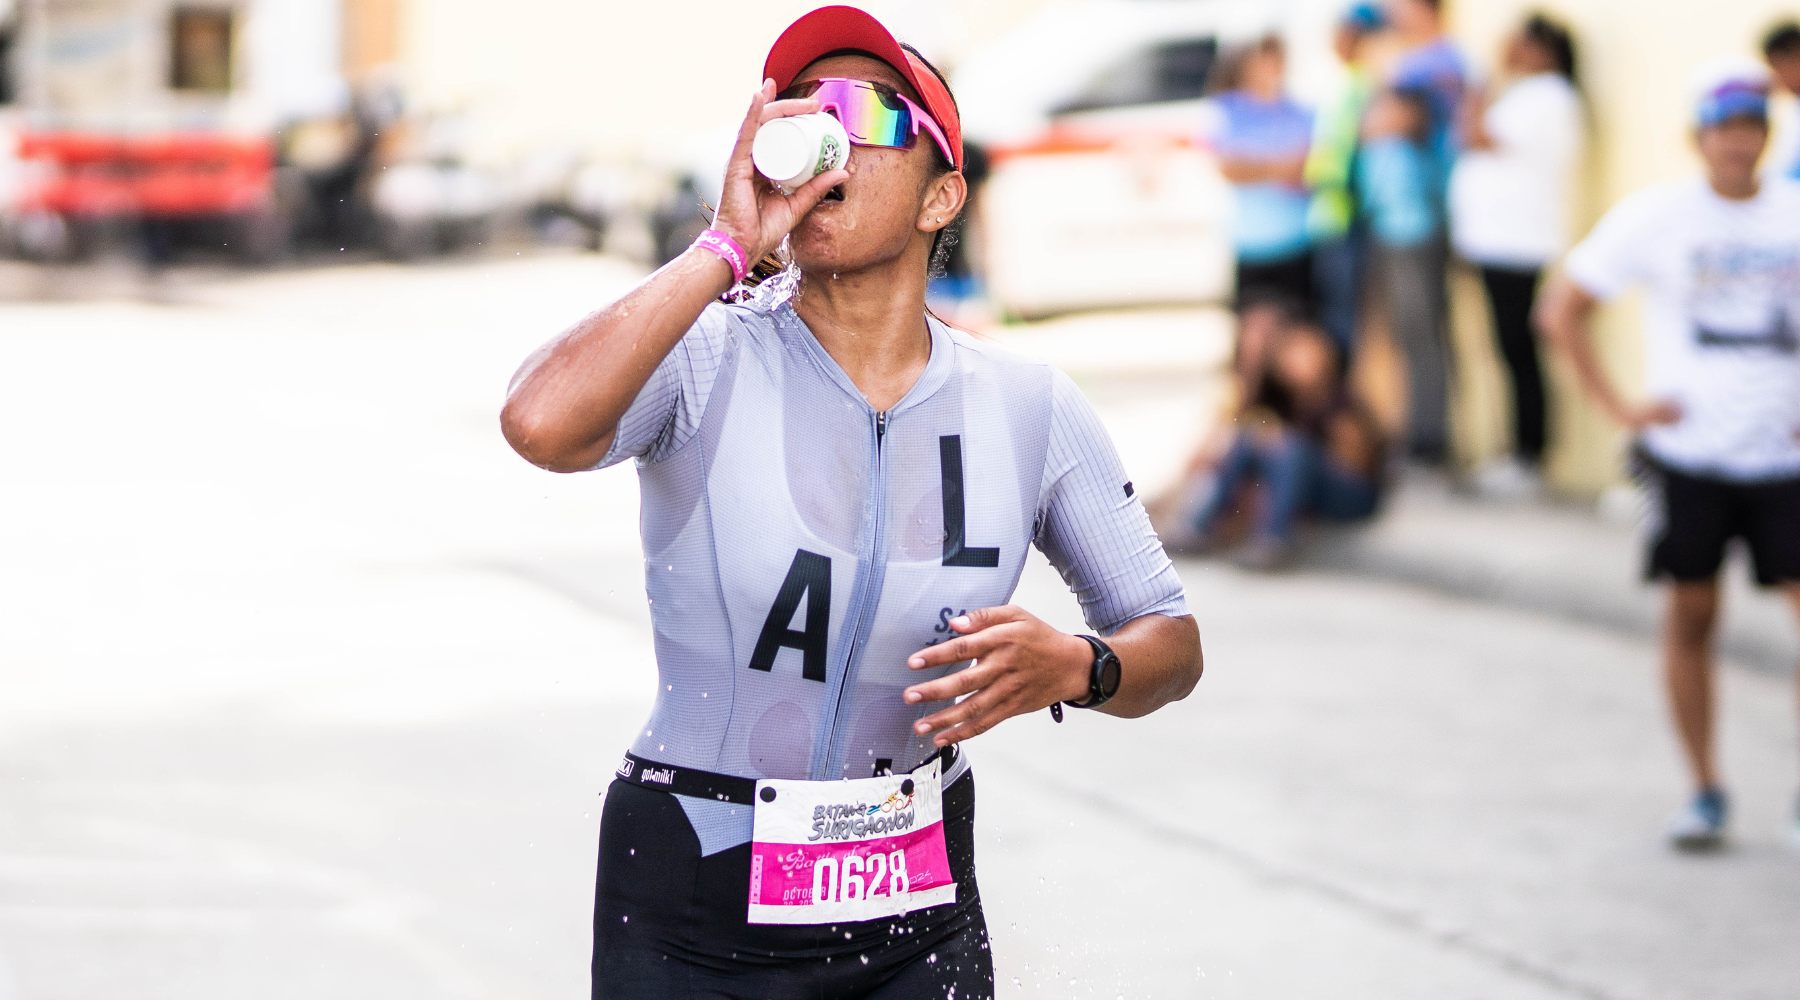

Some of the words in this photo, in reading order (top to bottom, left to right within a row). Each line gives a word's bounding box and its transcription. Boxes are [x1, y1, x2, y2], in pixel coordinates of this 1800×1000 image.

[939, 434, 1000, 568] L
[748, 548, 832, 683] A
[808, 807, 915, 841] SURIGAONON
[813, 803, 867, 821] BATANG
[783, 886, 827, 901] OCTOBR
[812, 849, 910, 905] 0628
[908, 869, 933, 885] 024
